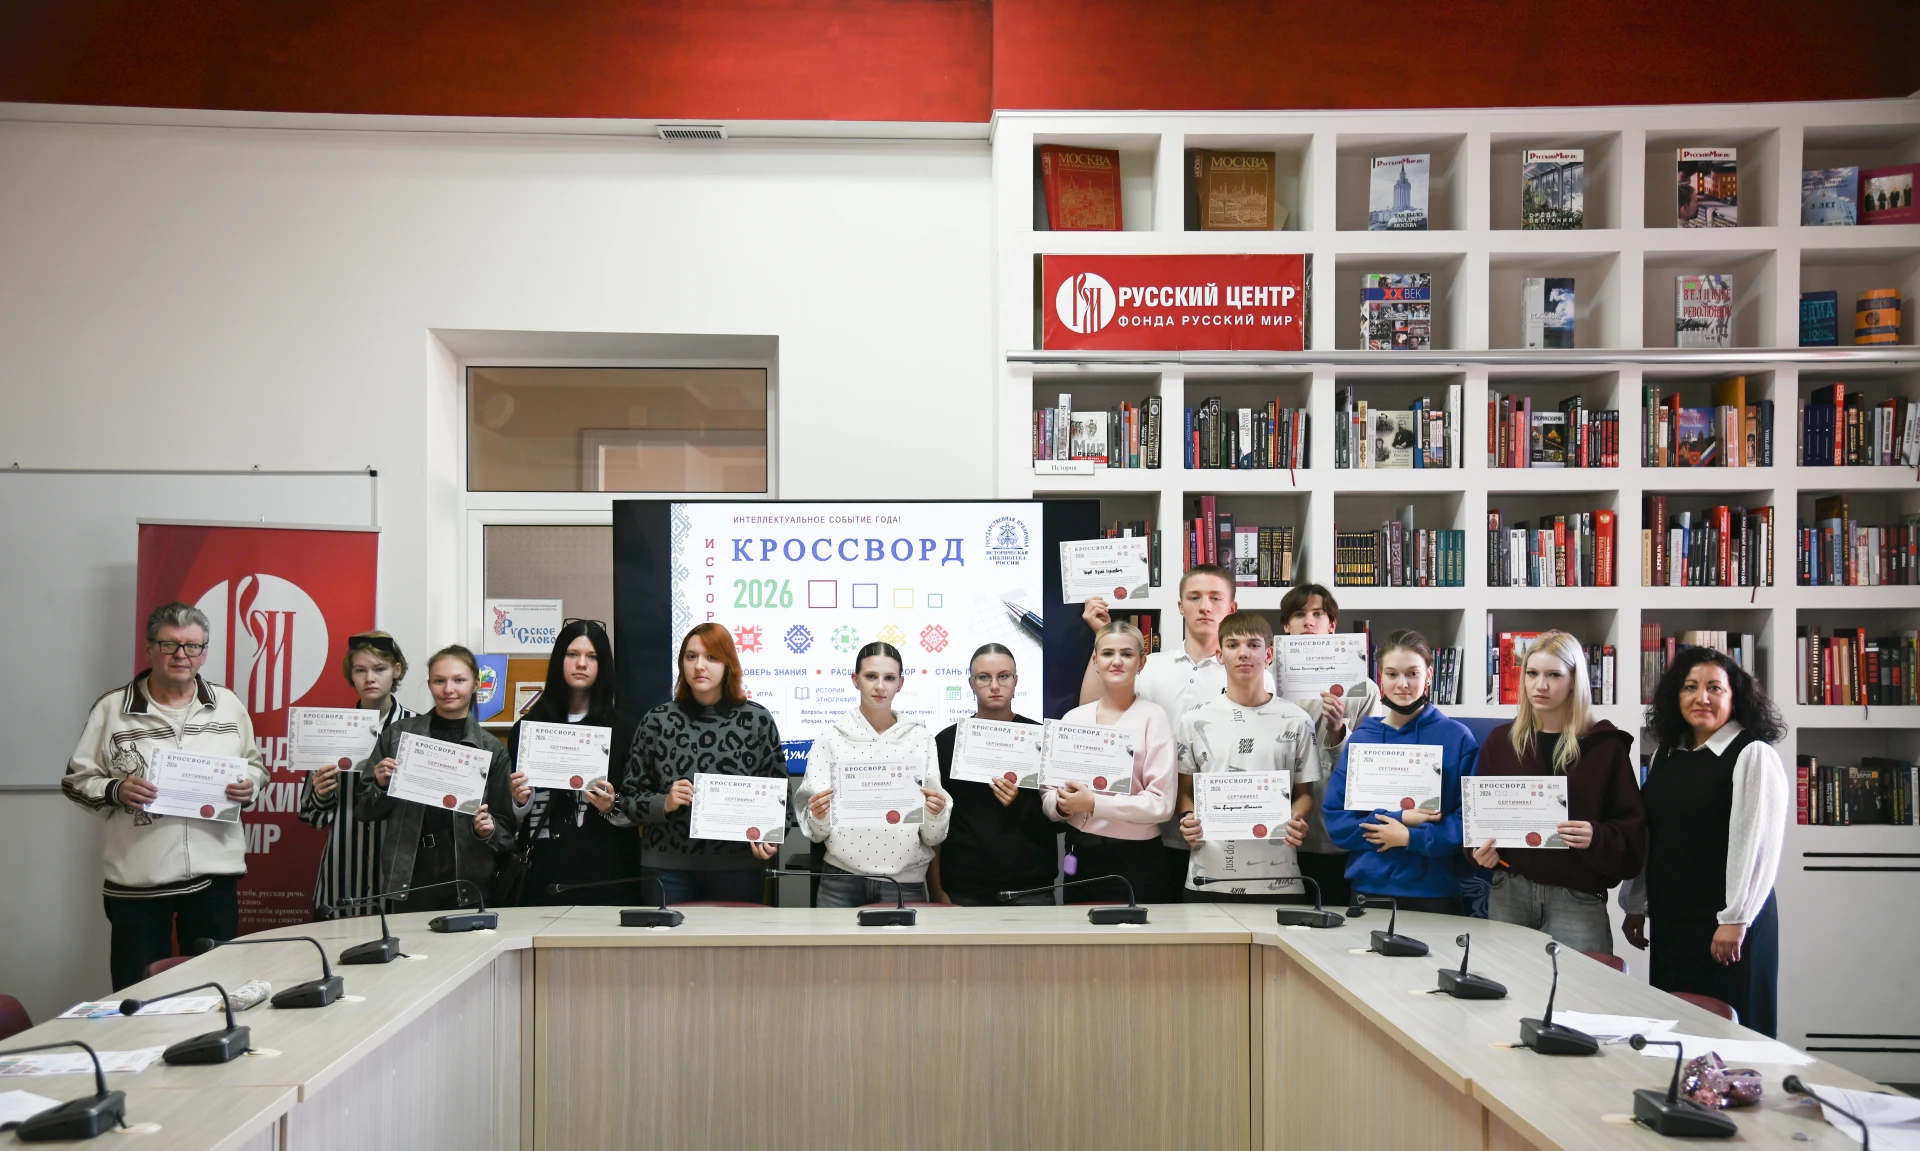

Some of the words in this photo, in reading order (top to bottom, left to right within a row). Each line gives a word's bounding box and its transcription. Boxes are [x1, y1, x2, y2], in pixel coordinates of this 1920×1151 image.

[1058, 152, 1112, 166] МОСКВА
[1211, 156, 1268, 168] МОСКВА
[1118, 282, 1218, 307] РУССКИЙ
[1226, 286, 1296, 310] ЦЕНТР
[1404, 288, 1422, 299] ВЕК
[1118, 314, 1176, 328] ФОНДА
[1182, 312, 1254, 326] РУССКИЙ
[1260, 314, 1293, 326] МИР
[733, 516, 826, 524] ИНТЕЛЛЕКТУАЛЬНОЕ
[829, 516, 871, 524] СОБЫТИЕ
[874, 516, 901, 524] ГОДА!
[732, 538, 965, 567] КРОССВОРД
[733, 578, 793, 609] 2026
[972, 725, 1012, 733] КРОССВОРД
[1059, 727, 1101, 736] КРОССВОРД
[415, 742, 456, 755] КРОССВОРД
[168, 755, 211, 765] КРОССВОРД
[1224, 845, 1234, 854] do
[1223, 856, 1236, 872] just
[259, 890, 285, 898] русская
